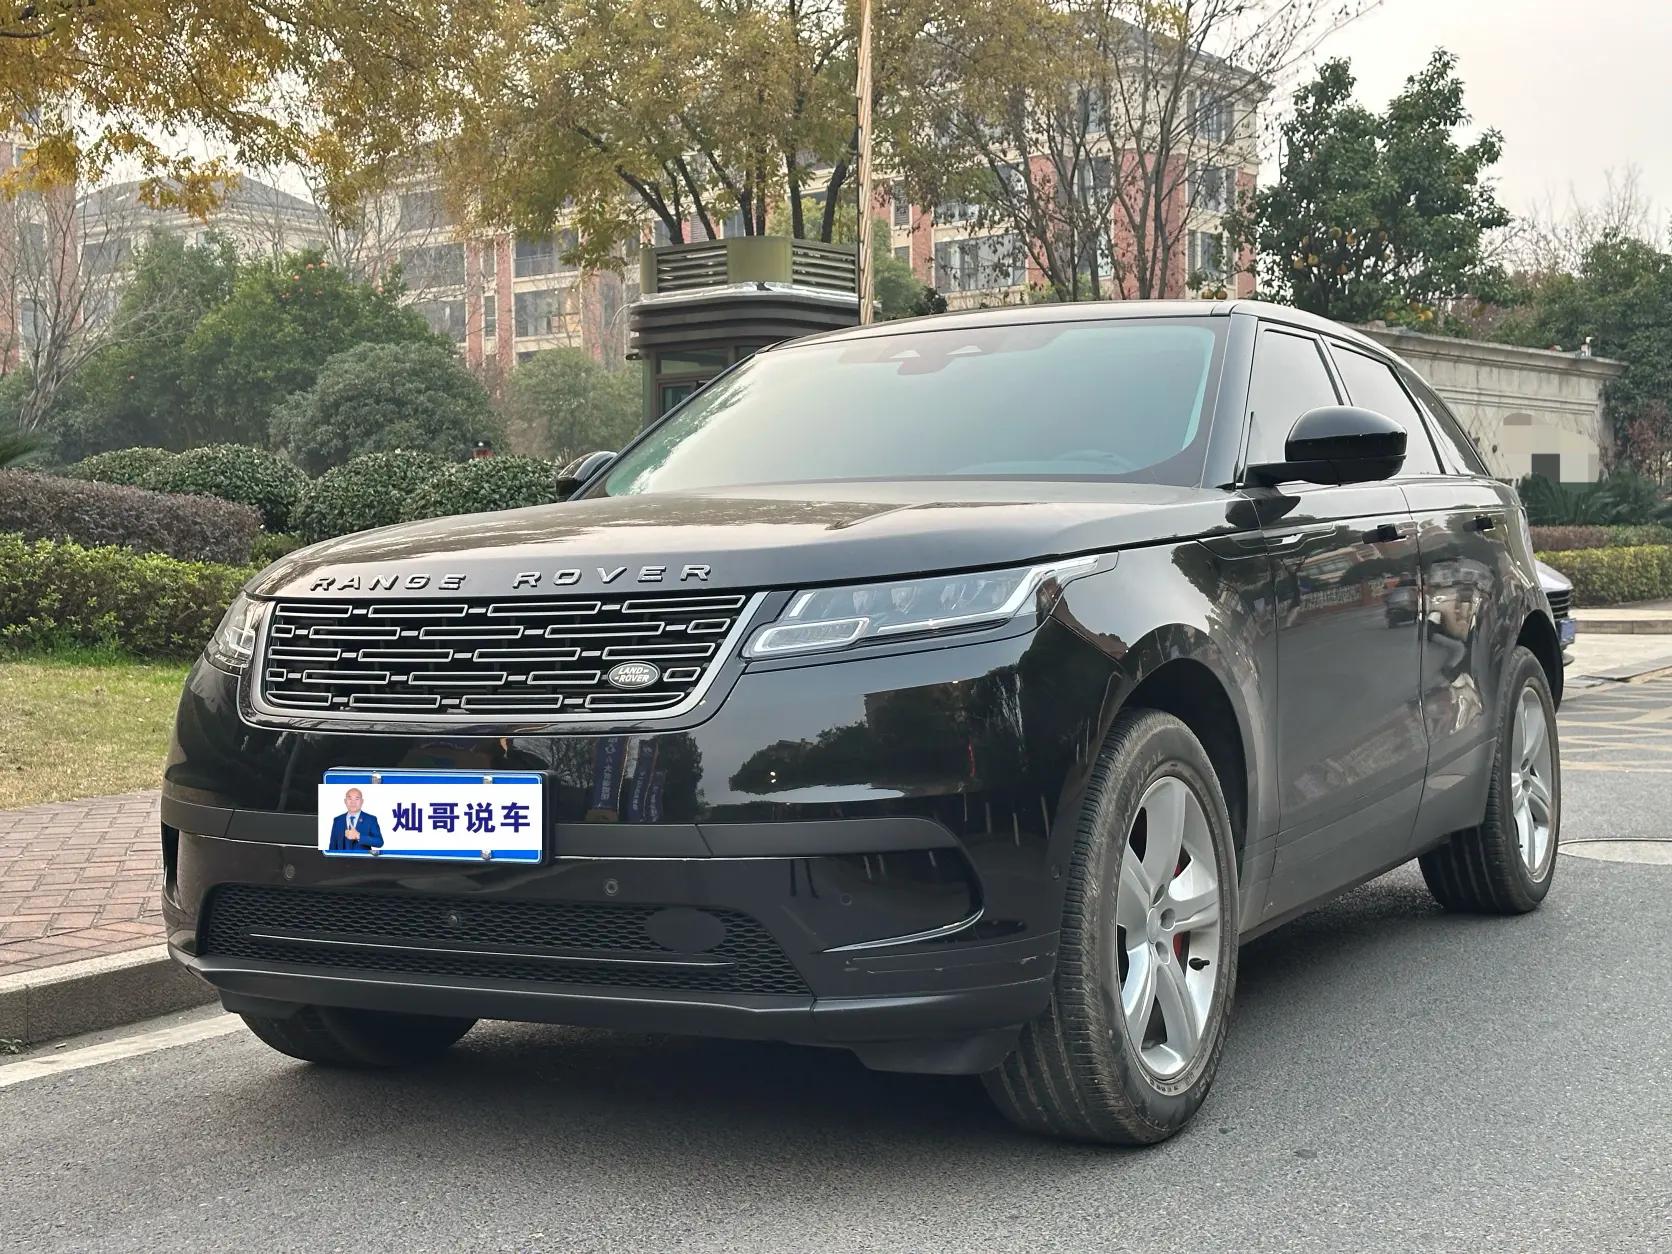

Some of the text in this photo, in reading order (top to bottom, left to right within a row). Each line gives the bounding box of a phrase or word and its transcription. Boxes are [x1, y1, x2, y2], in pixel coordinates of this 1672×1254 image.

[309, 564, 712, 592] RANGE ROVER
[618, 666, 644, 675] LAND
[618, 674, 650, 683] ROVER
